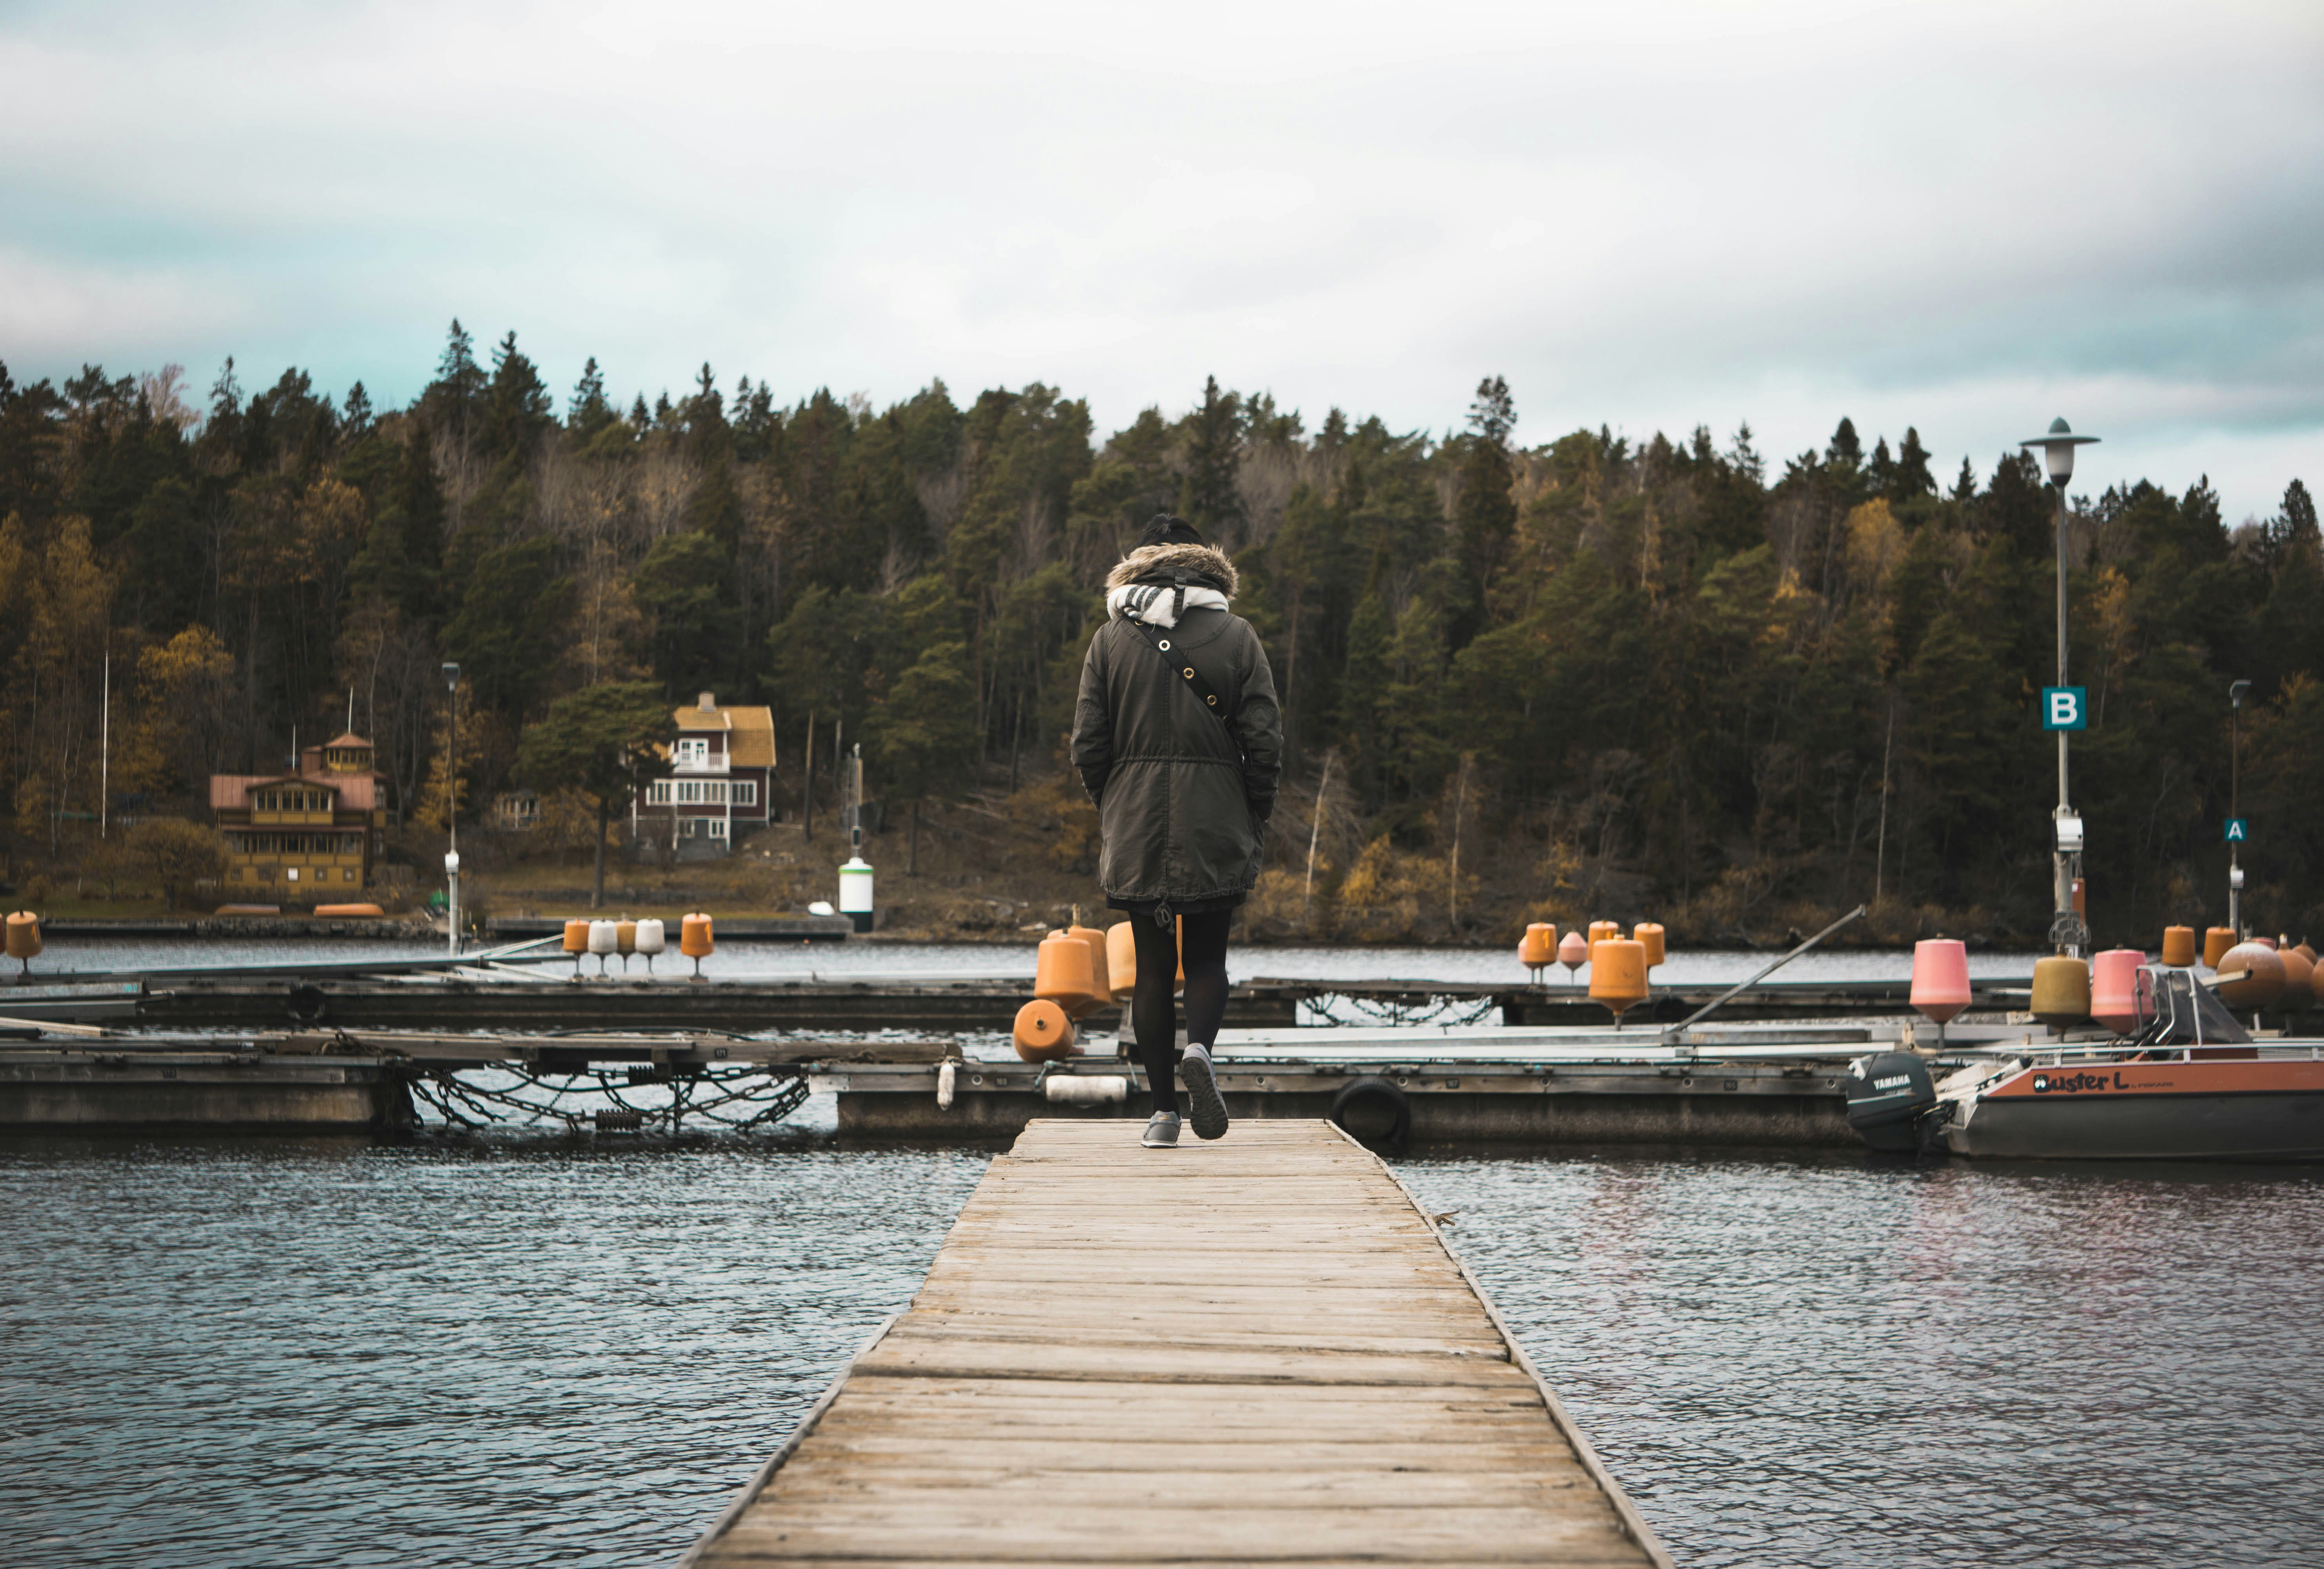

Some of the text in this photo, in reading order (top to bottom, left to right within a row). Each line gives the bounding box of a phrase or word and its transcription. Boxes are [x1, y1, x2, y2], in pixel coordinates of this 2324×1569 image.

[2051, 693, 2077, 725] B
[2228, 821, 2243, 839] A
[1542, 930, 1549, 948] 1
[1873, 1074, 1911, 1090] YAMAHA
[2033, 1072, 2109, 1093] Buster
[2114, 1071, 2129, 1090] L
